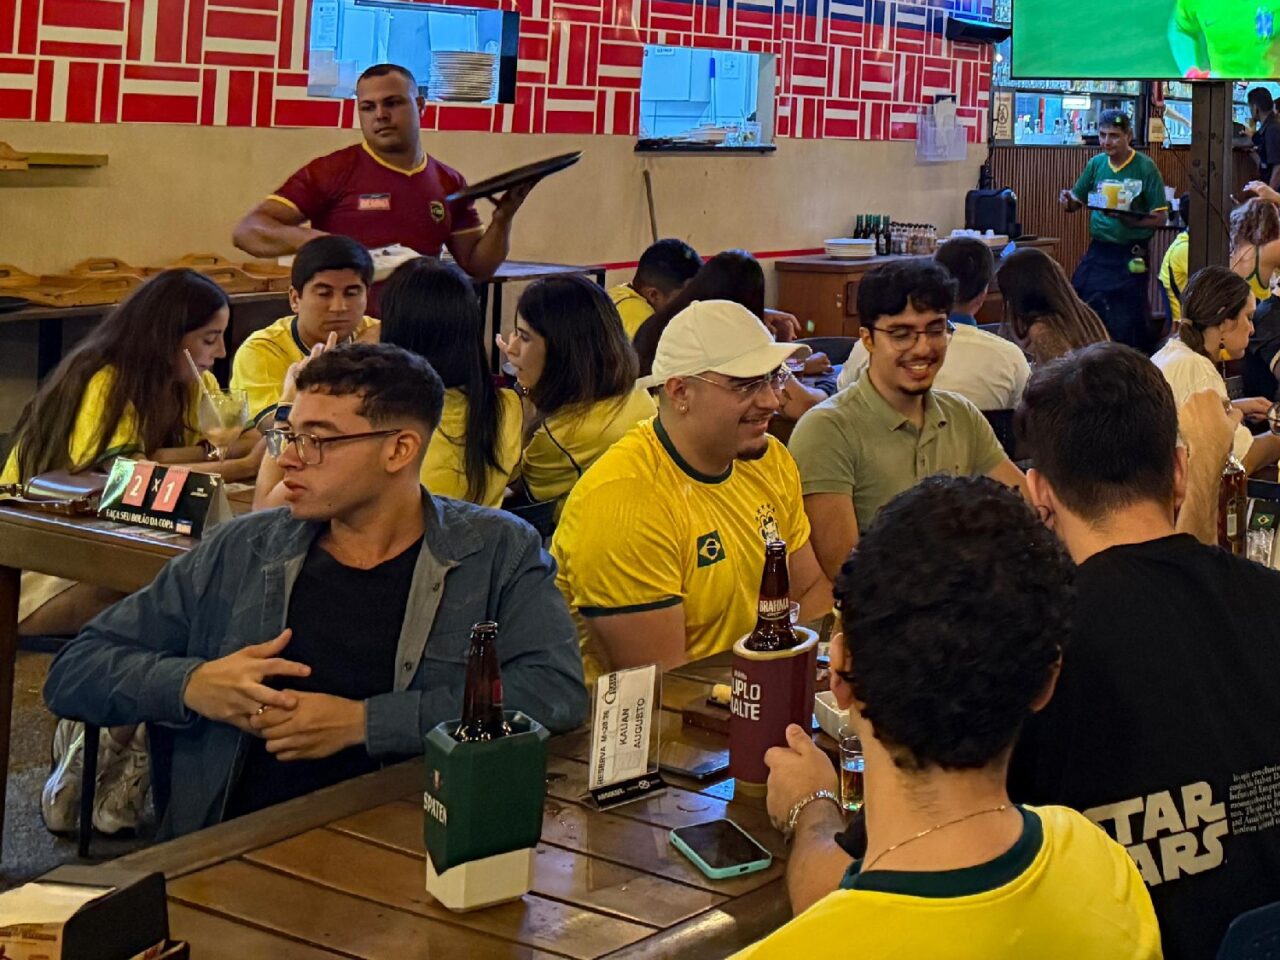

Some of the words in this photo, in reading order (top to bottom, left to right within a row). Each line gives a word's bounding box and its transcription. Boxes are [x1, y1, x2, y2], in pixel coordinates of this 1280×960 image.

[129, 475, 143, 497] 2
[163, 481, 176, 503] 1
[106, 509, 120, 520] FAÇA
[120, 511, 131, 521] SEU
[131, 513, 149, 525] BOLÃO
[158, 518, 174, 529] COPA
[759, 598, 789, 614] BRAHMA
[732, 678, 761, 701] UPLO
[619, 708, 630, 746] KAUAN
[633, 698, 645, 749] AUGUSTO
[597, 745, 606, 785] RESERVA
[423, 791, 447, 827] SPATEN
[1127, 819, 1229, 886] ARS
